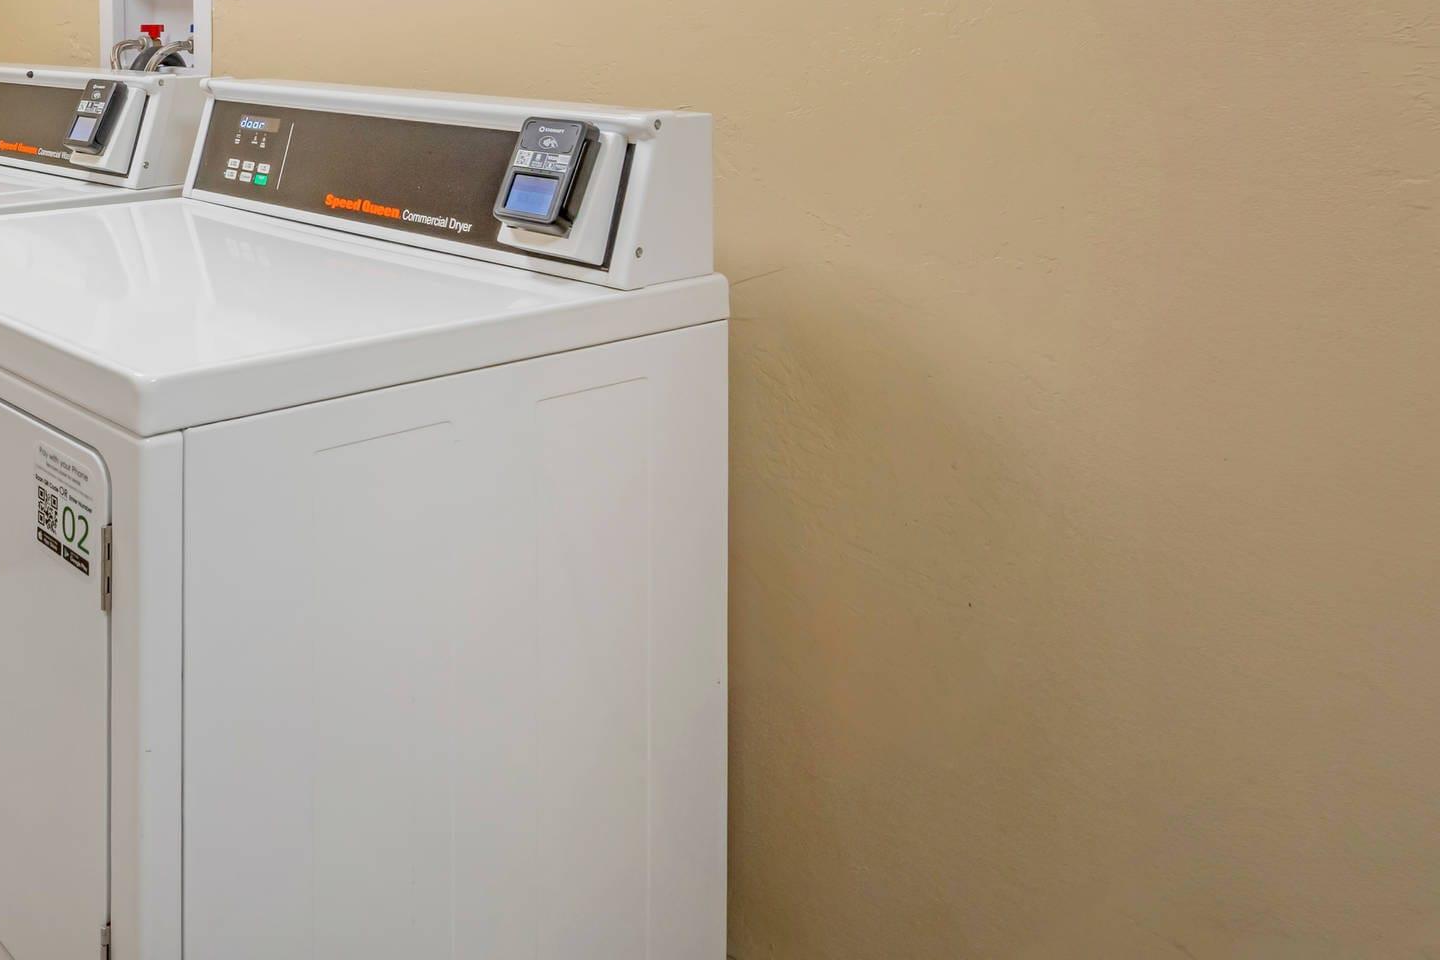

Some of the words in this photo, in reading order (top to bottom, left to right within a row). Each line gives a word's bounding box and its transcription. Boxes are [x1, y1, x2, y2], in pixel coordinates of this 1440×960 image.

[325, 192, 362, 209] Speed
[402, 209, 448, 228] Commercial
[449, 217, 473, 234] Dryer
[71, 465, 89, 482] Phone
[62, 506, 90, 556] 02
